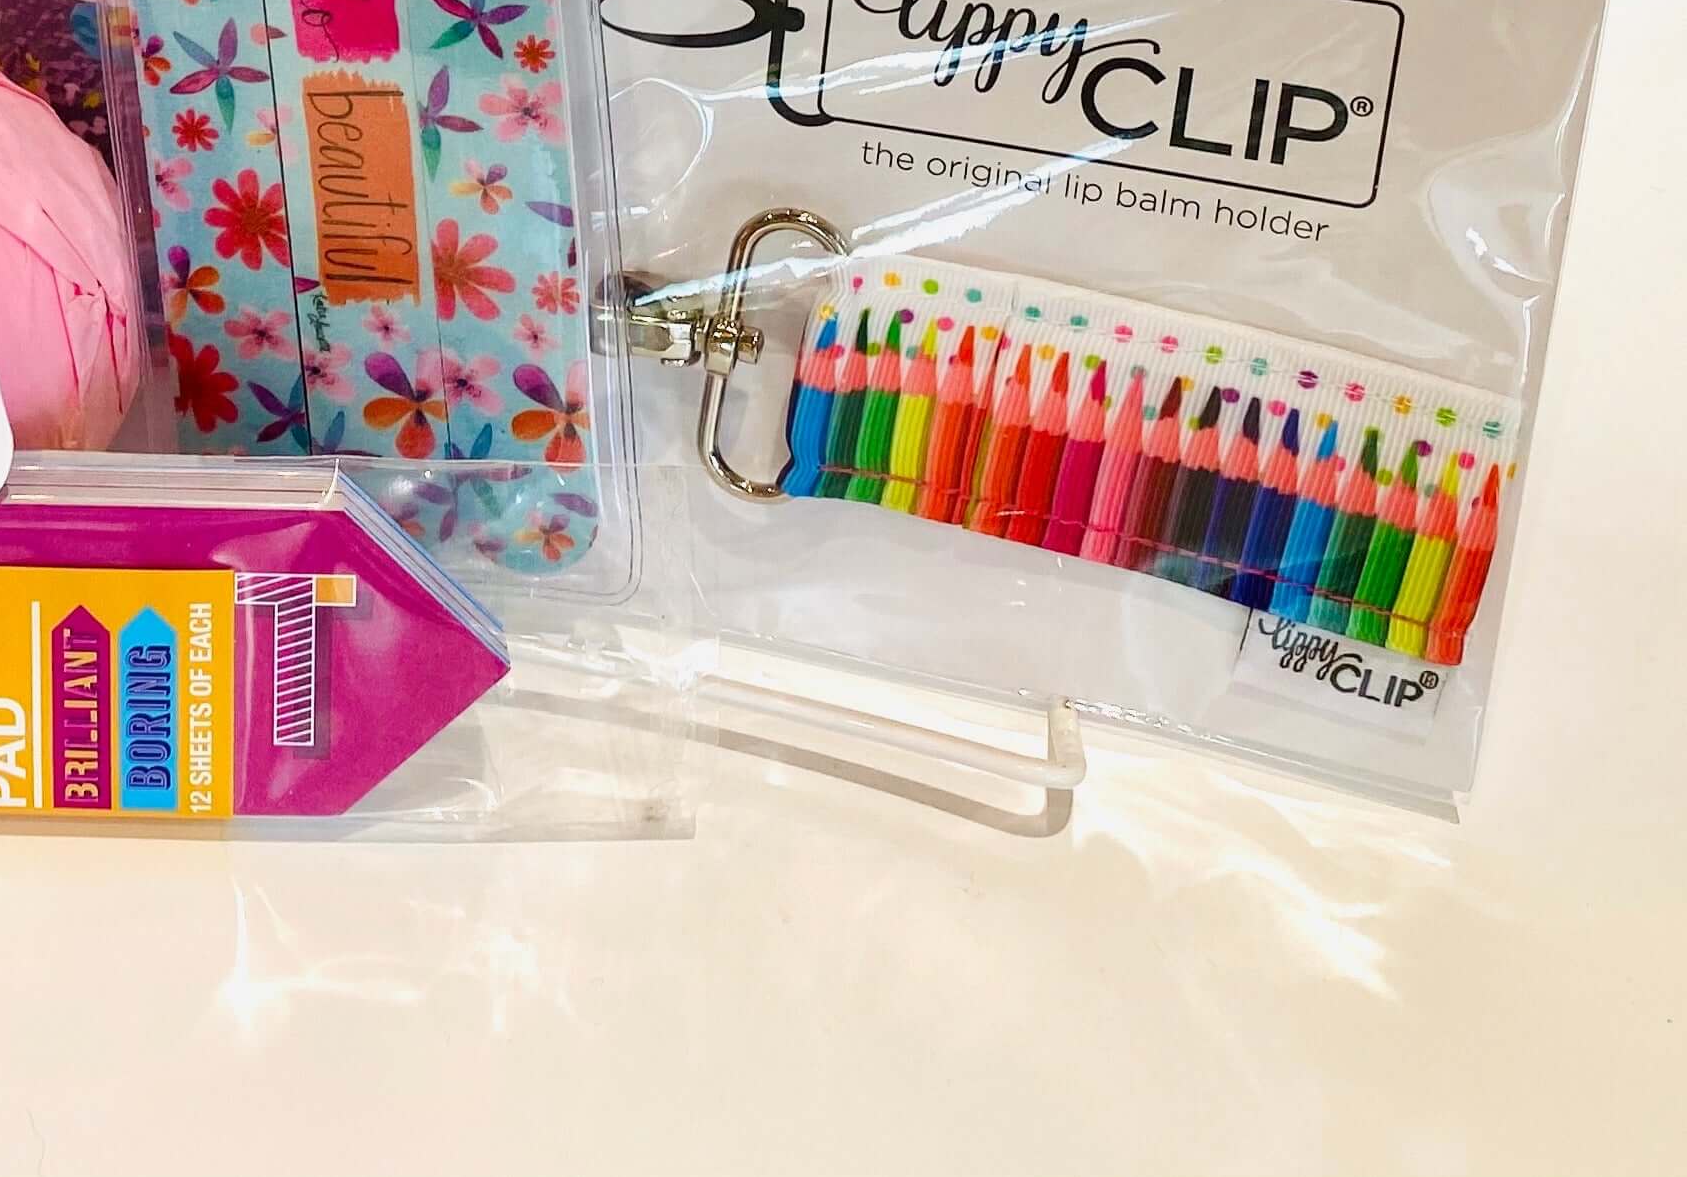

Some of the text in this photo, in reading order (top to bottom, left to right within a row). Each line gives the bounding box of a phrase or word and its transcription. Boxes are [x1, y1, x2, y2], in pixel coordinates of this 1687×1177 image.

[306, 86, 415, 288] beautiful
[860, 139, 1330, 245] the original lip balm holder
[63, 628, 100, 803] BRILLIANT
[126, 644, 172, 791] BORING
[189, 602, 213, 814] 12 SHEETS OF EACH
